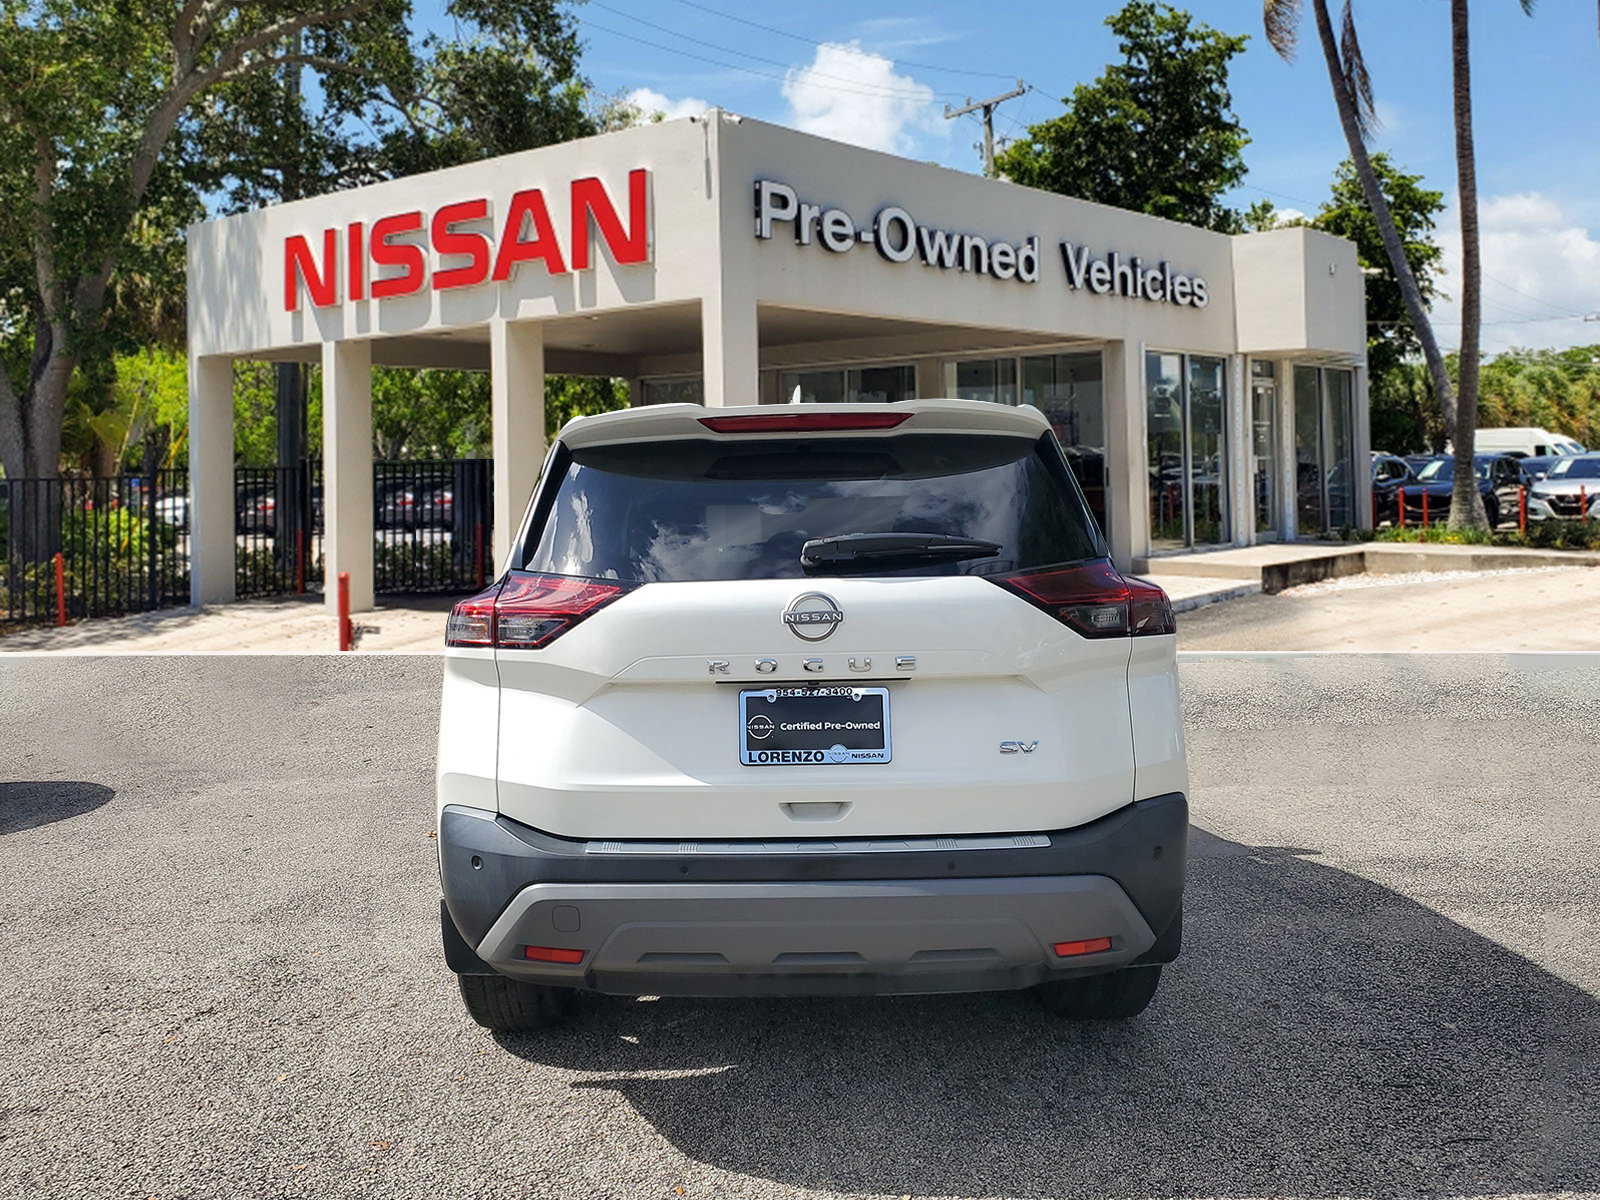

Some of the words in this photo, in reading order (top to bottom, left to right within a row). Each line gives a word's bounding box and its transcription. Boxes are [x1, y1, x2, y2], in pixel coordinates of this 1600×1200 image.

[285, 168, 650, 312] NISSAN
[754, 180, 1040, 283] Pre-Owned
[1061, 241, 1209, 309] Vehicles
[785, 612, 842, 622] NISSAN
[708, 655, 917, 675] ROGUE
[775, 687, 853, 697] 954-527-3400
[780, 721, 822, 731] Certified
[824, 721, 880, 730] Pre-Owned
[999, 740, 1039, 755] SV
[748, 751, 825, 763] LORENZO
